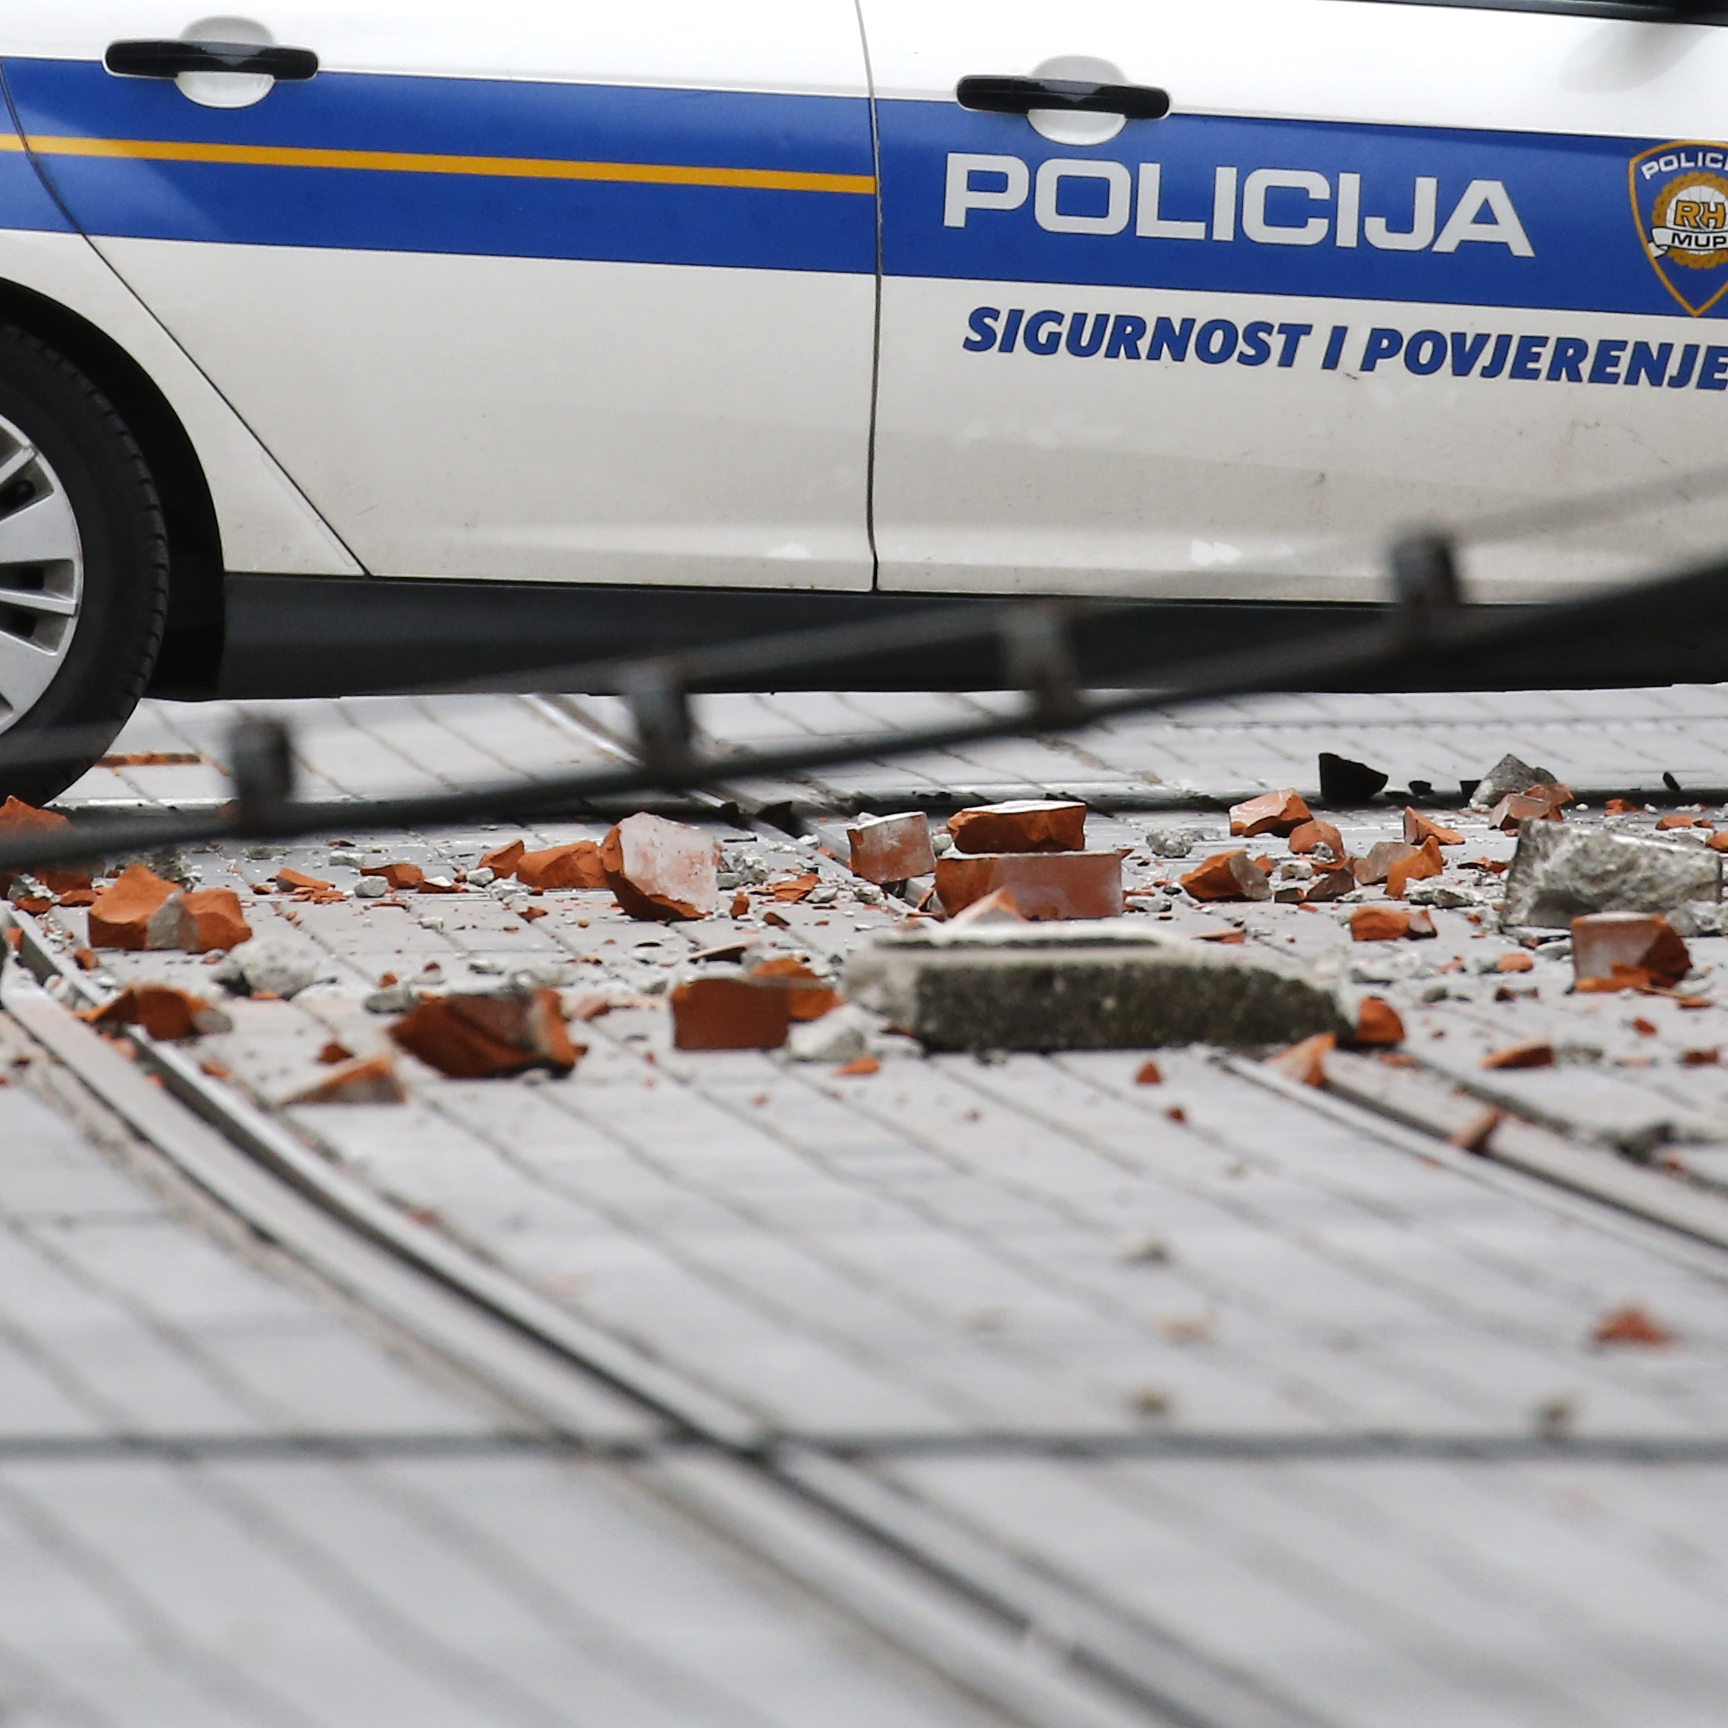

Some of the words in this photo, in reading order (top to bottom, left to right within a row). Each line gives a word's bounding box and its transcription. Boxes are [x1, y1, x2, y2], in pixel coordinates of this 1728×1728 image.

[943, 151, 1536, 258] POLICIJA
[1673, 199, 1727, 229] RH
[1671, 232, 1728, 248] MUP
[962, 306, 1313, 368] SIGURNOST
[1321, 326, 1349, 371] I
